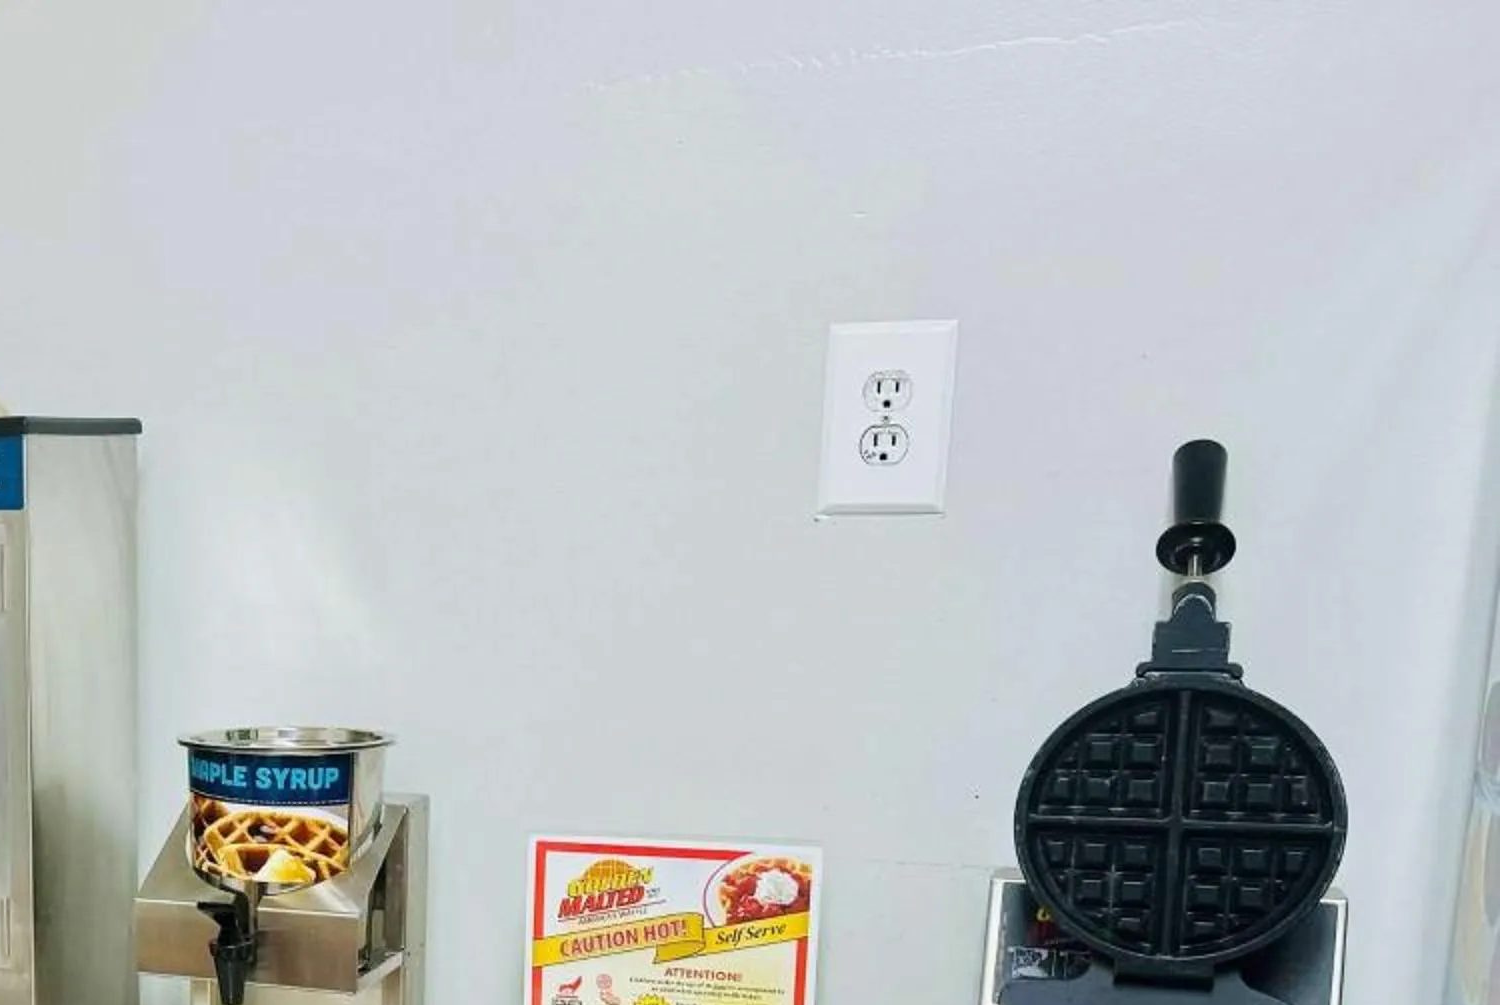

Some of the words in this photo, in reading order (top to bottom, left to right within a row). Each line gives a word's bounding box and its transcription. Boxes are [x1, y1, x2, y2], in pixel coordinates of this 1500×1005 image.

[255, 766, 340, 790] SYRUP
[557, 885, 645, 918] MALTED
[560, 928, 639, 957] CAUTION
[644, 920, 688, 940] HOT!
[716, 928, 744, 948] Self
[745, 922, 787, 940] Serve
[664, 967, 742, 982] ATTENTION!
